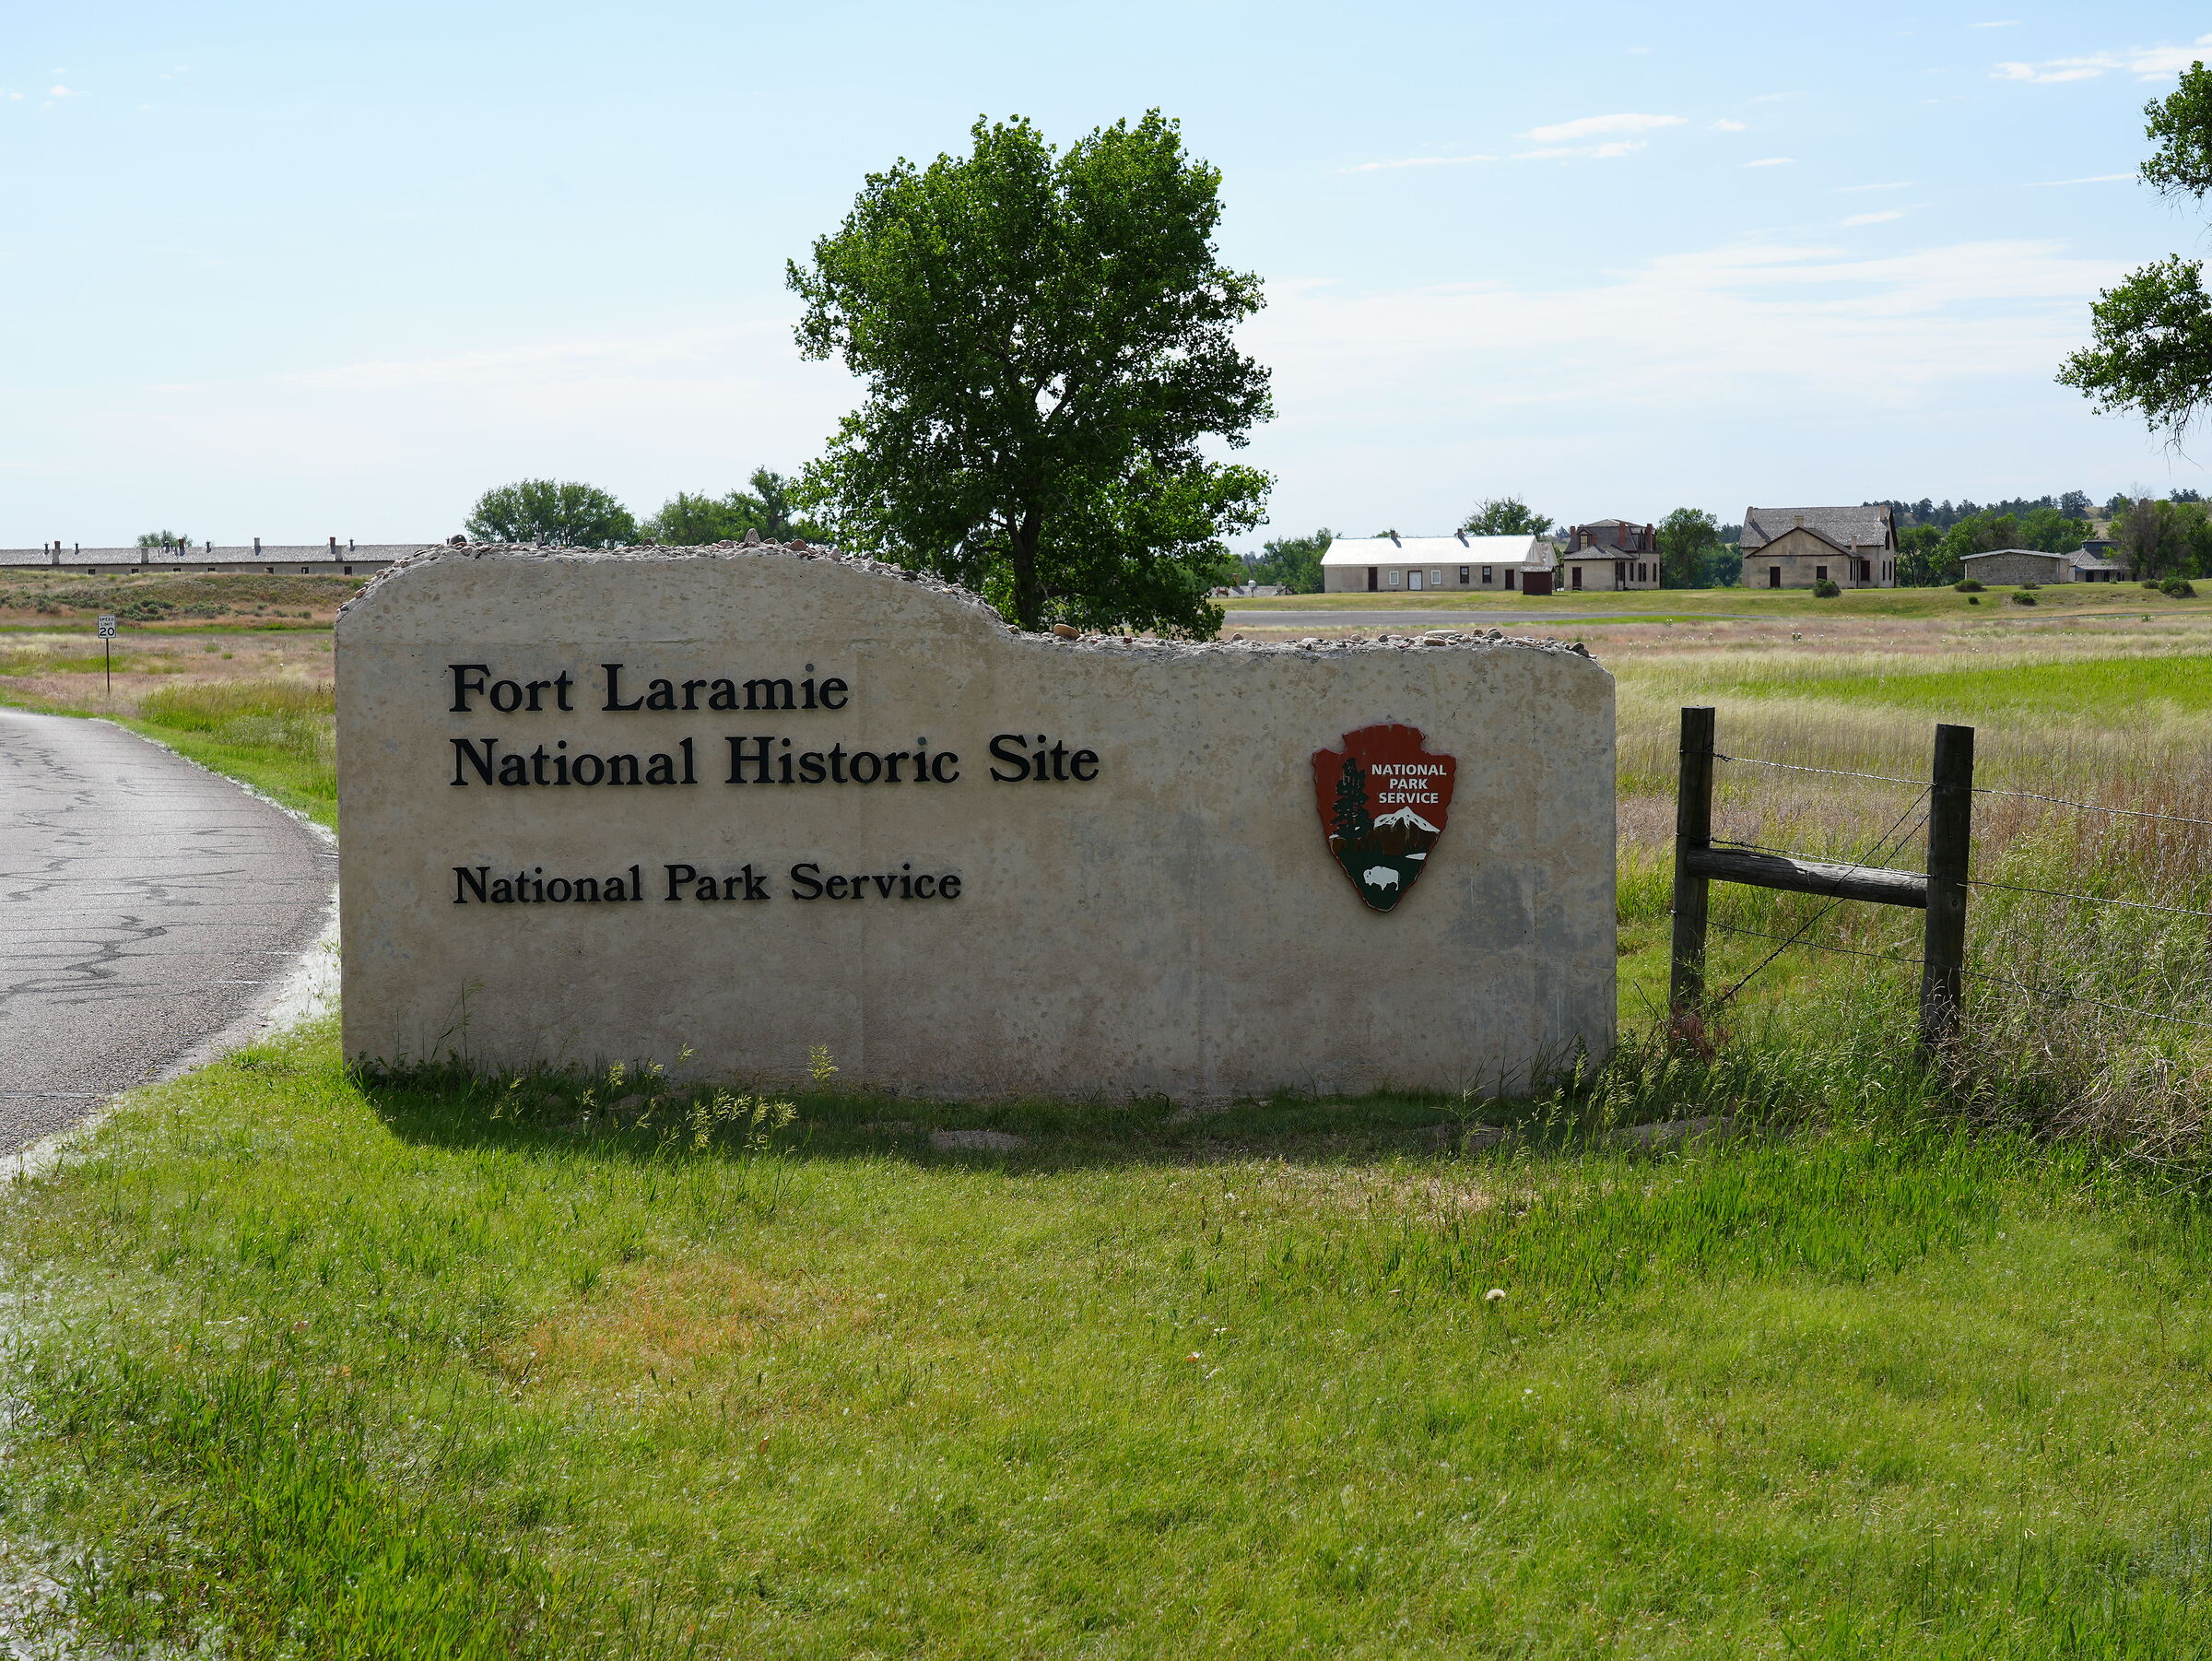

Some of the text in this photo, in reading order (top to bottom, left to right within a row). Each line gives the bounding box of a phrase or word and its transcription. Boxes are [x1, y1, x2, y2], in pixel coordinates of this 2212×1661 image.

[99, 627, 115, 636] 20
[448, 663, 848, 713] Fort Laramie
[450, 734, 1099, 786] National Historic Site
[1371, 764, 1447, 776] NATIONAL
[1389, 778, 1429, 790] PARK
[1379, 792, 1439, 804] SERVICE
[452, 863, 961, 904] National Park Service
